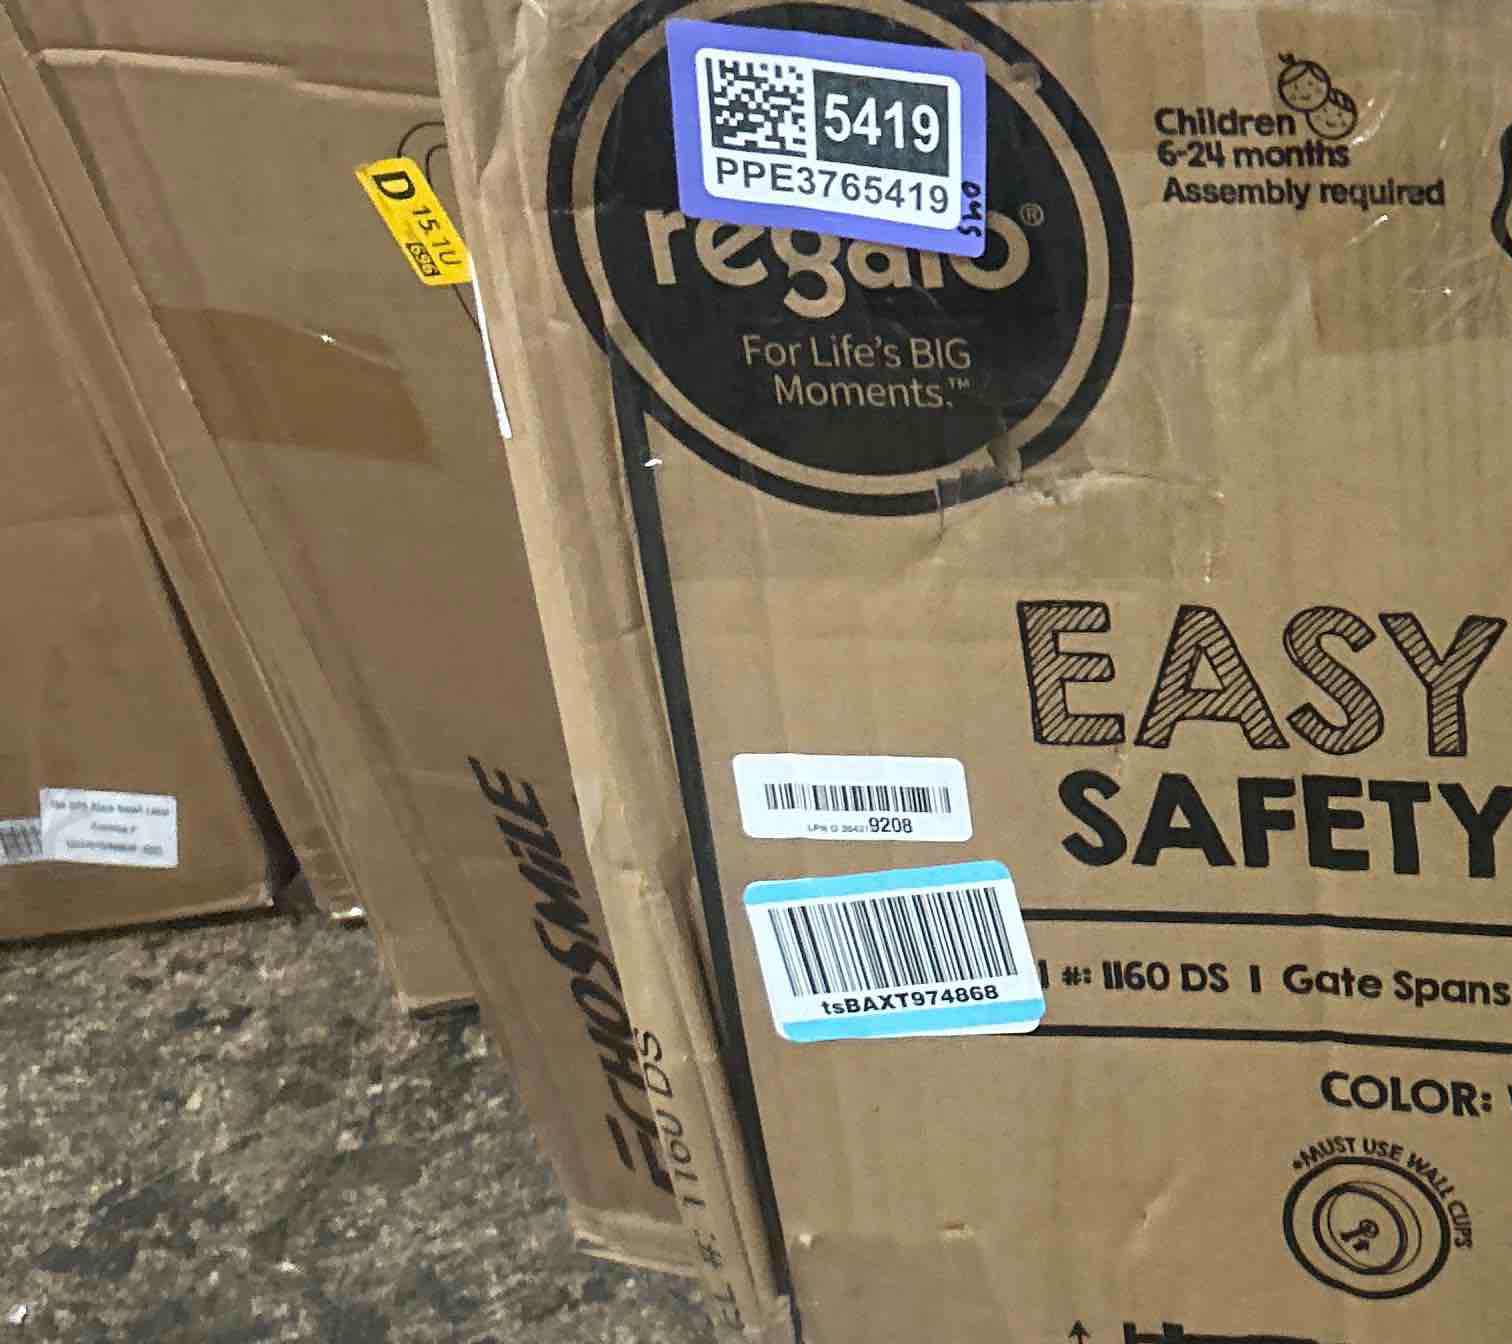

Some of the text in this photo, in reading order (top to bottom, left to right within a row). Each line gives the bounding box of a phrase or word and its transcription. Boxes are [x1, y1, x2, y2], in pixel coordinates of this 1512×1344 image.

[823, 93, 941, 153] 5419
[1154, 107, 1296, 137] Children
[1157, 140, 1350, 168] 6-24 months
[371, 170, 416, 200] D
[716, 157, 950, 214] PPE3765419
[1163, 177, 1445, 211] Assembly required
[743, 334, 971, 369] For Life's BIG
[1017, 600, 1506, 758] EASY
[821, 984, 999, 1015] tsBAXT974868
[1181, 961, 1229, 993] DS
[1282, 965, 1383, 997] Gate
[1393, 970, 1511, 1008] Spans
[1320, 1070, 1493, 1117] COLOR:
[1362, 1138, 1403, 1160] USE
[1407, 1153, 1455, 1202] WALL
[1447, 1200, 1473, 1250] CUPS
